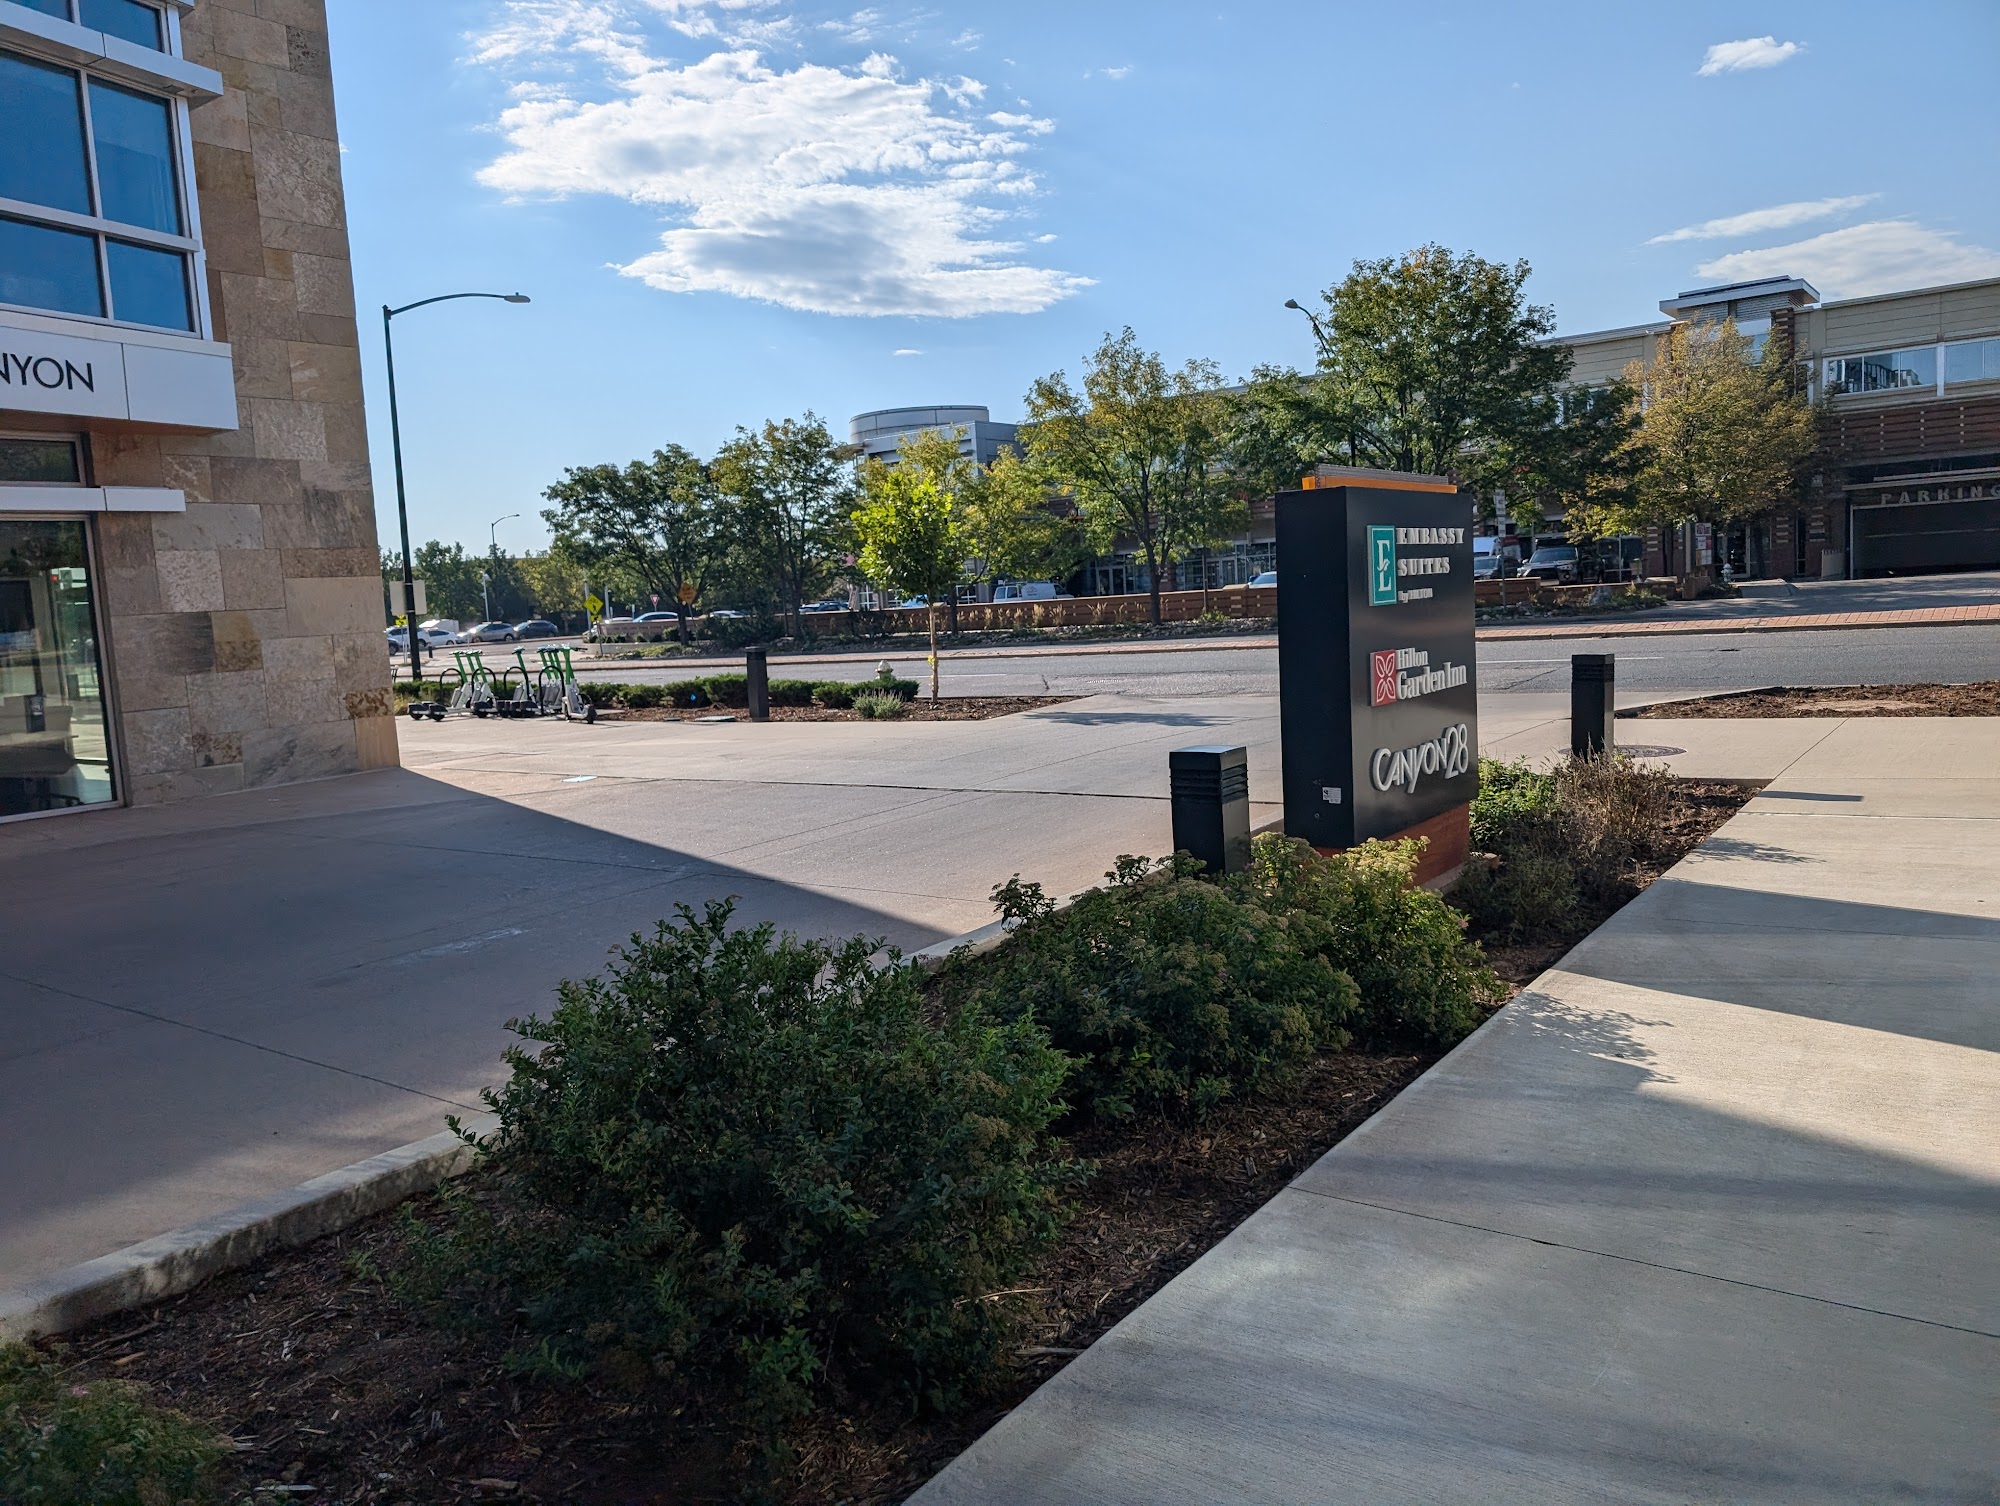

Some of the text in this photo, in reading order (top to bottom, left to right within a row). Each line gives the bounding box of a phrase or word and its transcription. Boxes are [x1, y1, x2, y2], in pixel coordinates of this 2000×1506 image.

[1881, 485, 2000, 504] PARKING
[1396, 528, 1464, 545] EMBASSY
[1397, 557, 1450, 576] SUITES
[1395, 647, 1429, 670] Hilton
